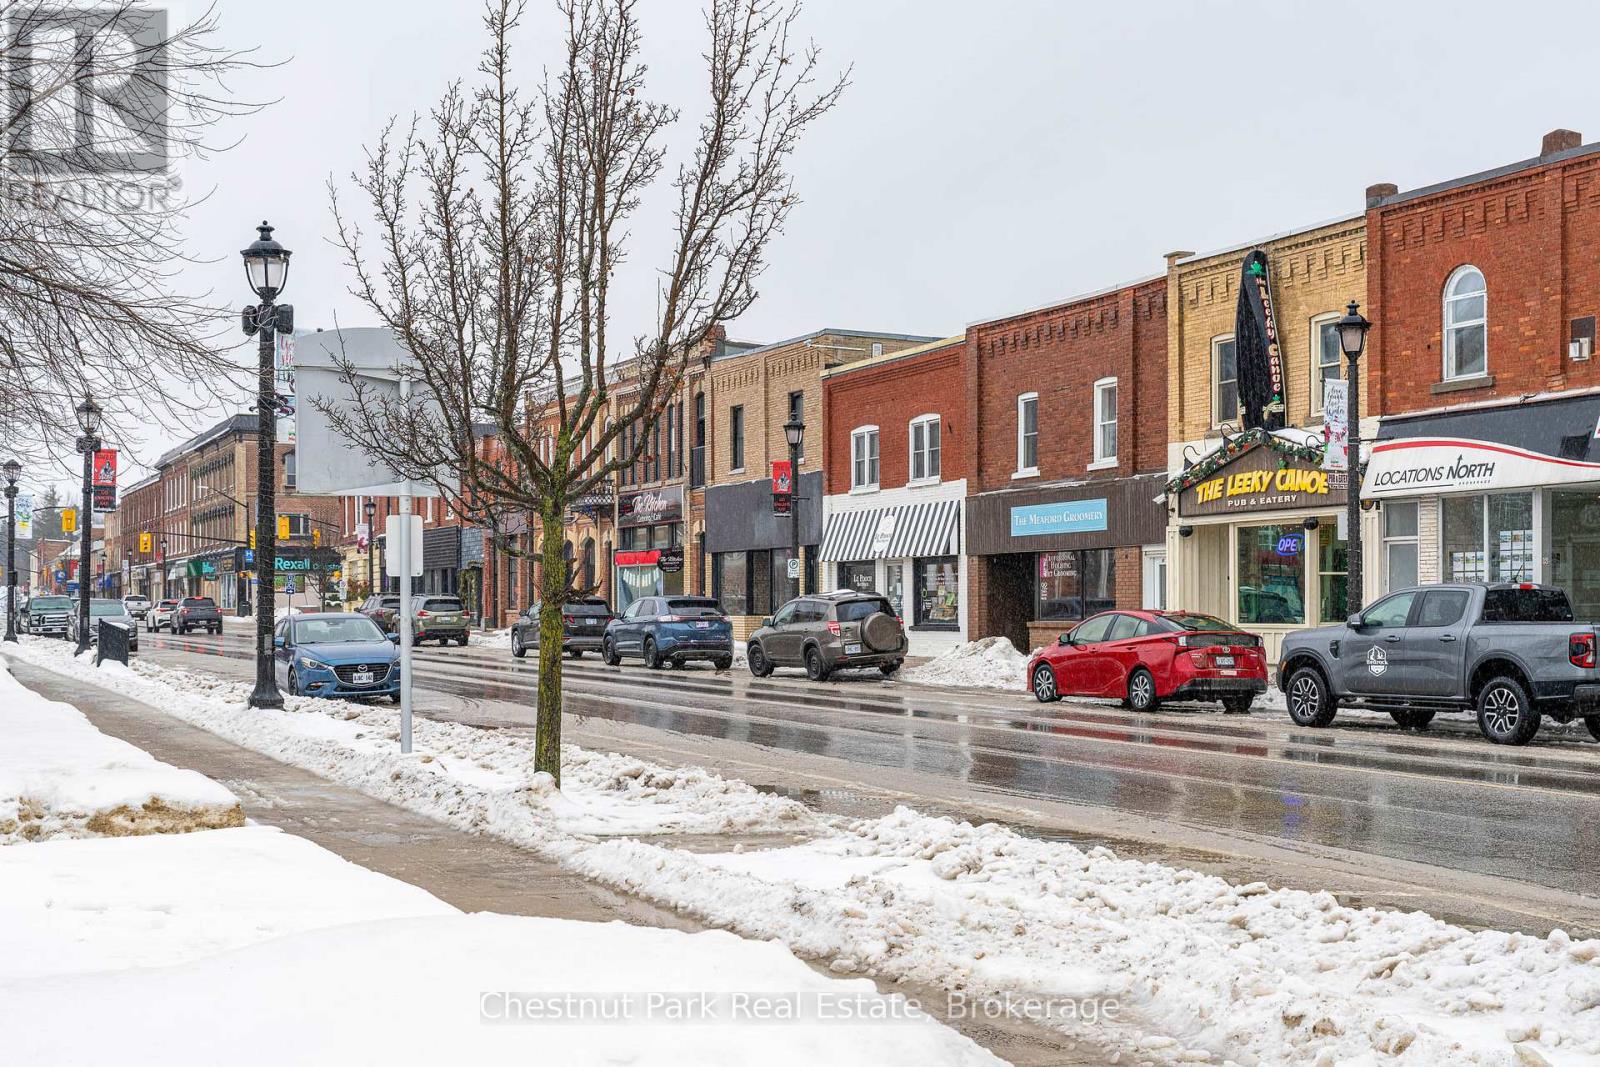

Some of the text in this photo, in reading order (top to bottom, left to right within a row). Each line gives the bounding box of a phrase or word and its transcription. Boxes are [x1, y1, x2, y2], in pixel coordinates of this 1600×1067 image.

[1374, 466, 1445, 486] LOCATIONS
[1446, 455, 1495, 480] NORTH
[1195, 477, 1225, 505] THE
[1227, 470, 1274, 497] LEEKY
[1276, 468, 1330, 495] CANOE
[1228, 498, 1246, 507] PUB
[1260, 494, 1298, 505] EATERY
[1014, 510, 1104, 526] THE MEAFORD GROOMERY
[274, 557, 311, 571] Rexall
